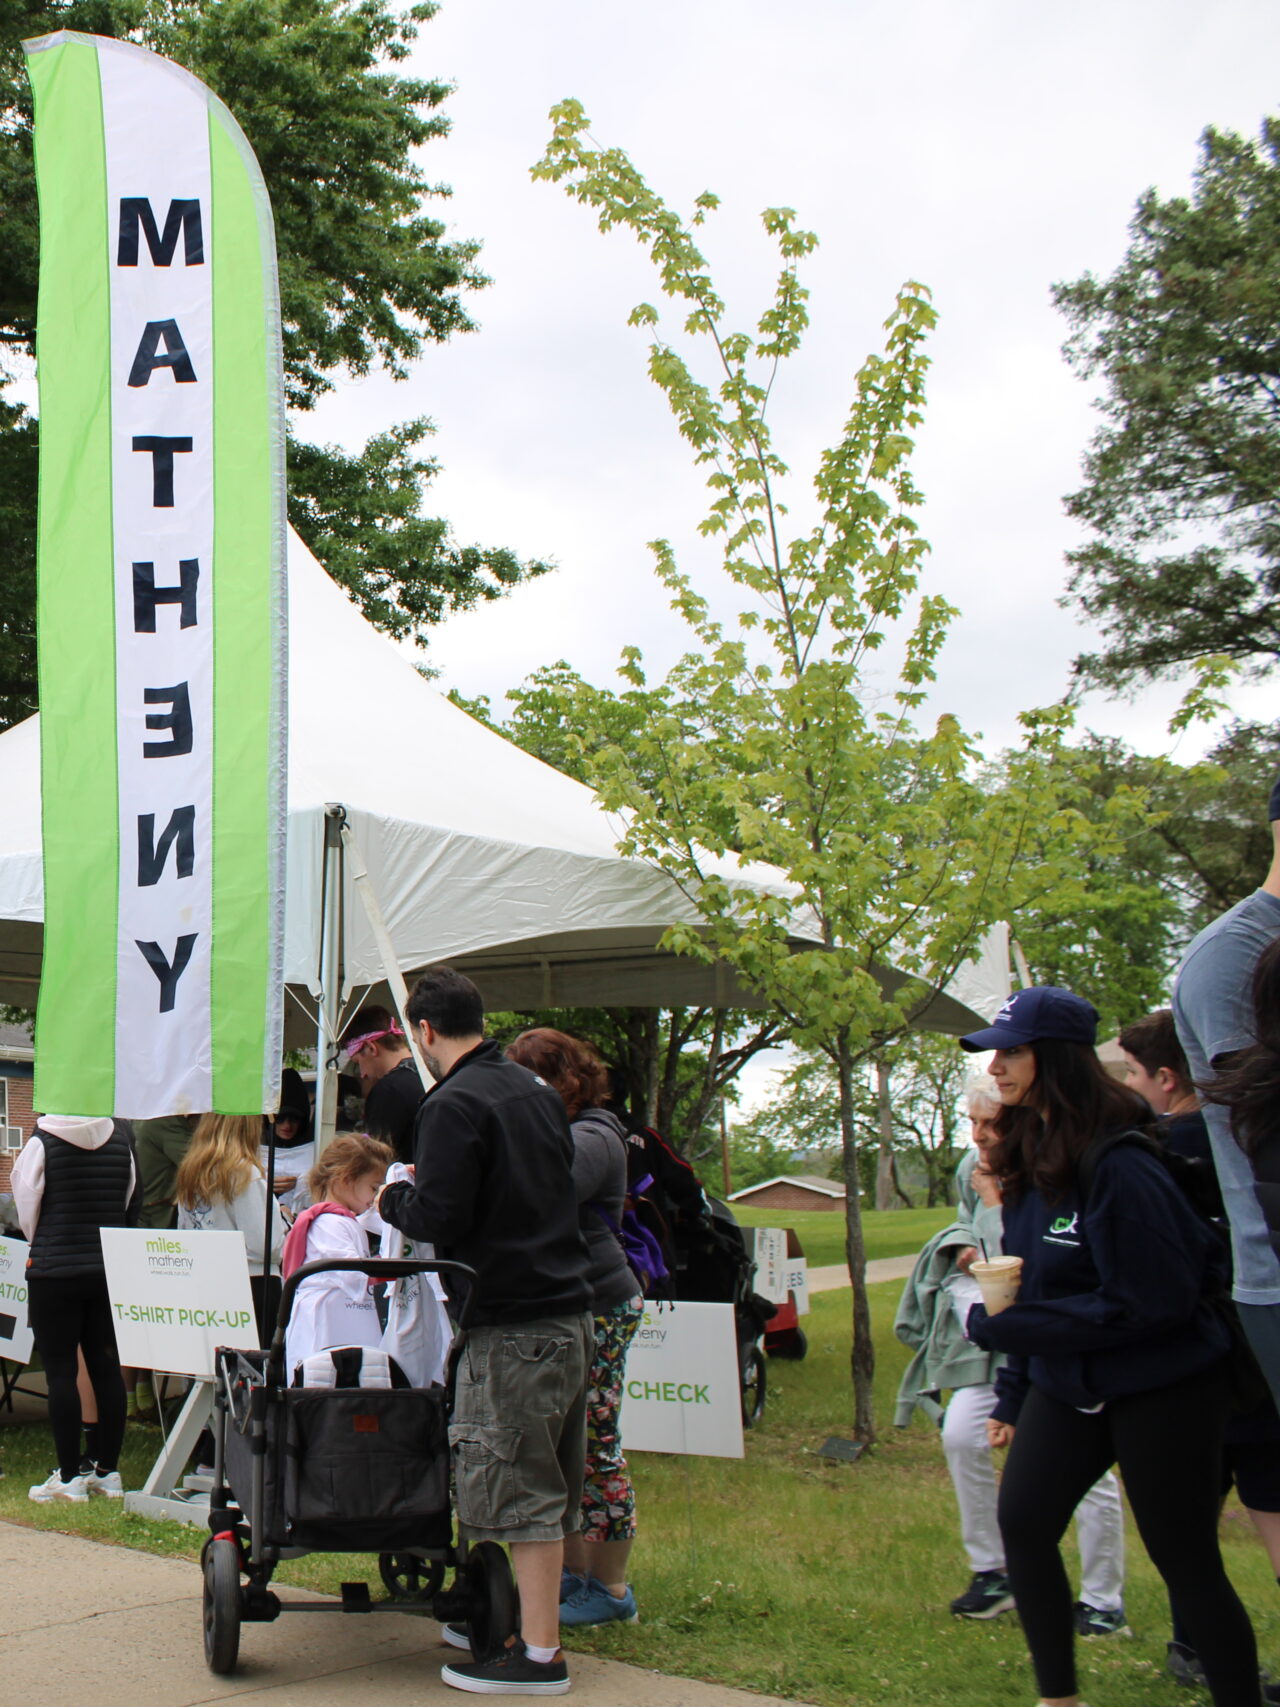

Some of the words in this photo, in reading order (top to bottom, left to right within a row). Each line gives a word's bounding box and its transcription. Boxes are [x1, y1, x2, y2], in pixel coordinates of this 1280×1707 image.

[145, 1237, 182, 1254] miles
[148, 1255, 193, 1270] matheny
[114, 1303, 174, 1325] T-SHIRT
[178, 1308, 251, 1329] PICK-UP
[627, 1380, 711, 1405] CHECK
